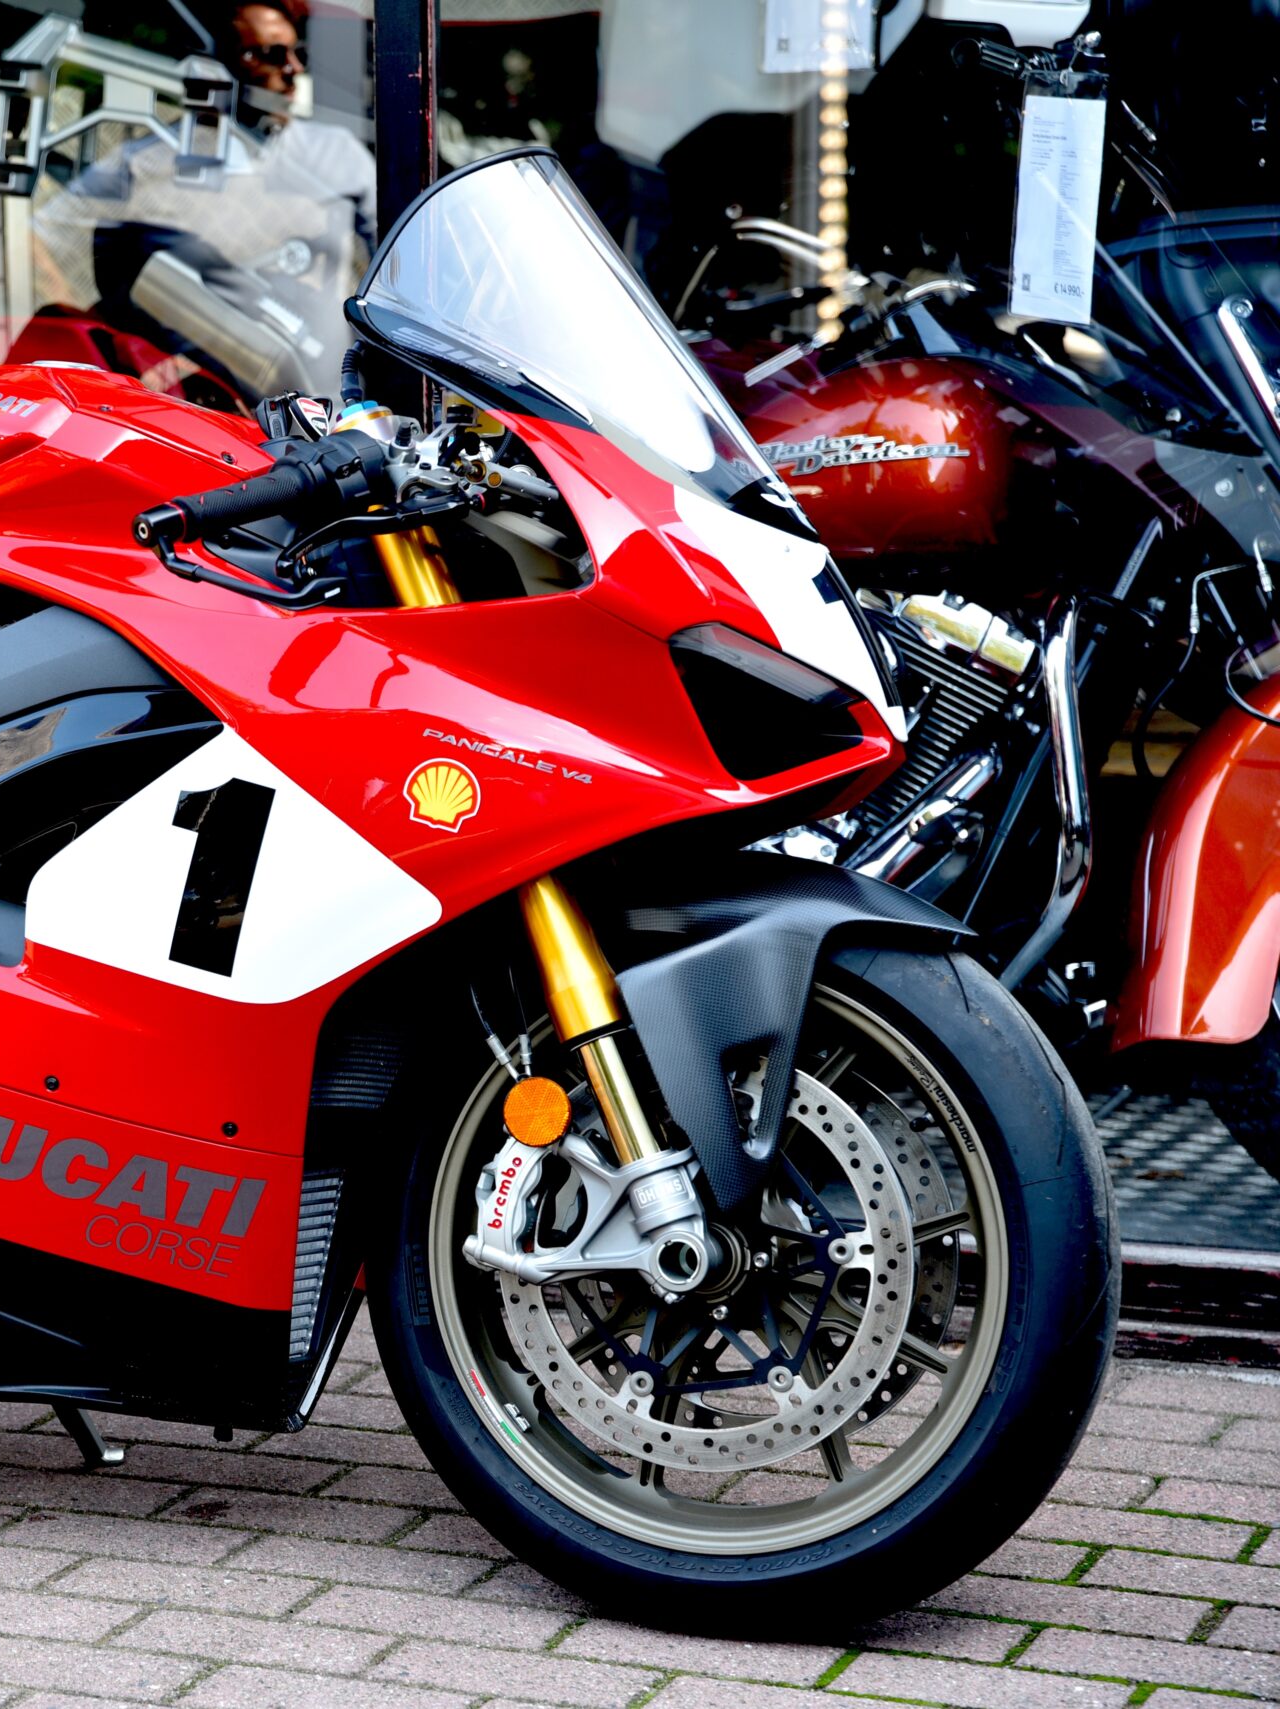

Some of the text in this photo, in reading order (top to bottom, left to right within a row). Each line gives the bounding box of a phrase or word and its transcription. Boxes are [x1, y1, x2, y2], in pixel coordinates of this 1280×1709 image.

[790, 440, 970, 477] Davidson
[422, 727, 593, 784] PANIGALE V4
[169, 777, 276, 977] 1
[929, 1086, 977, 1153] marchesini
[487, 1156, 523, 1230] brembo
[637, 1179, 684, 1205] ÖHNS
[85, 1214, 241, 1278] CORSE
